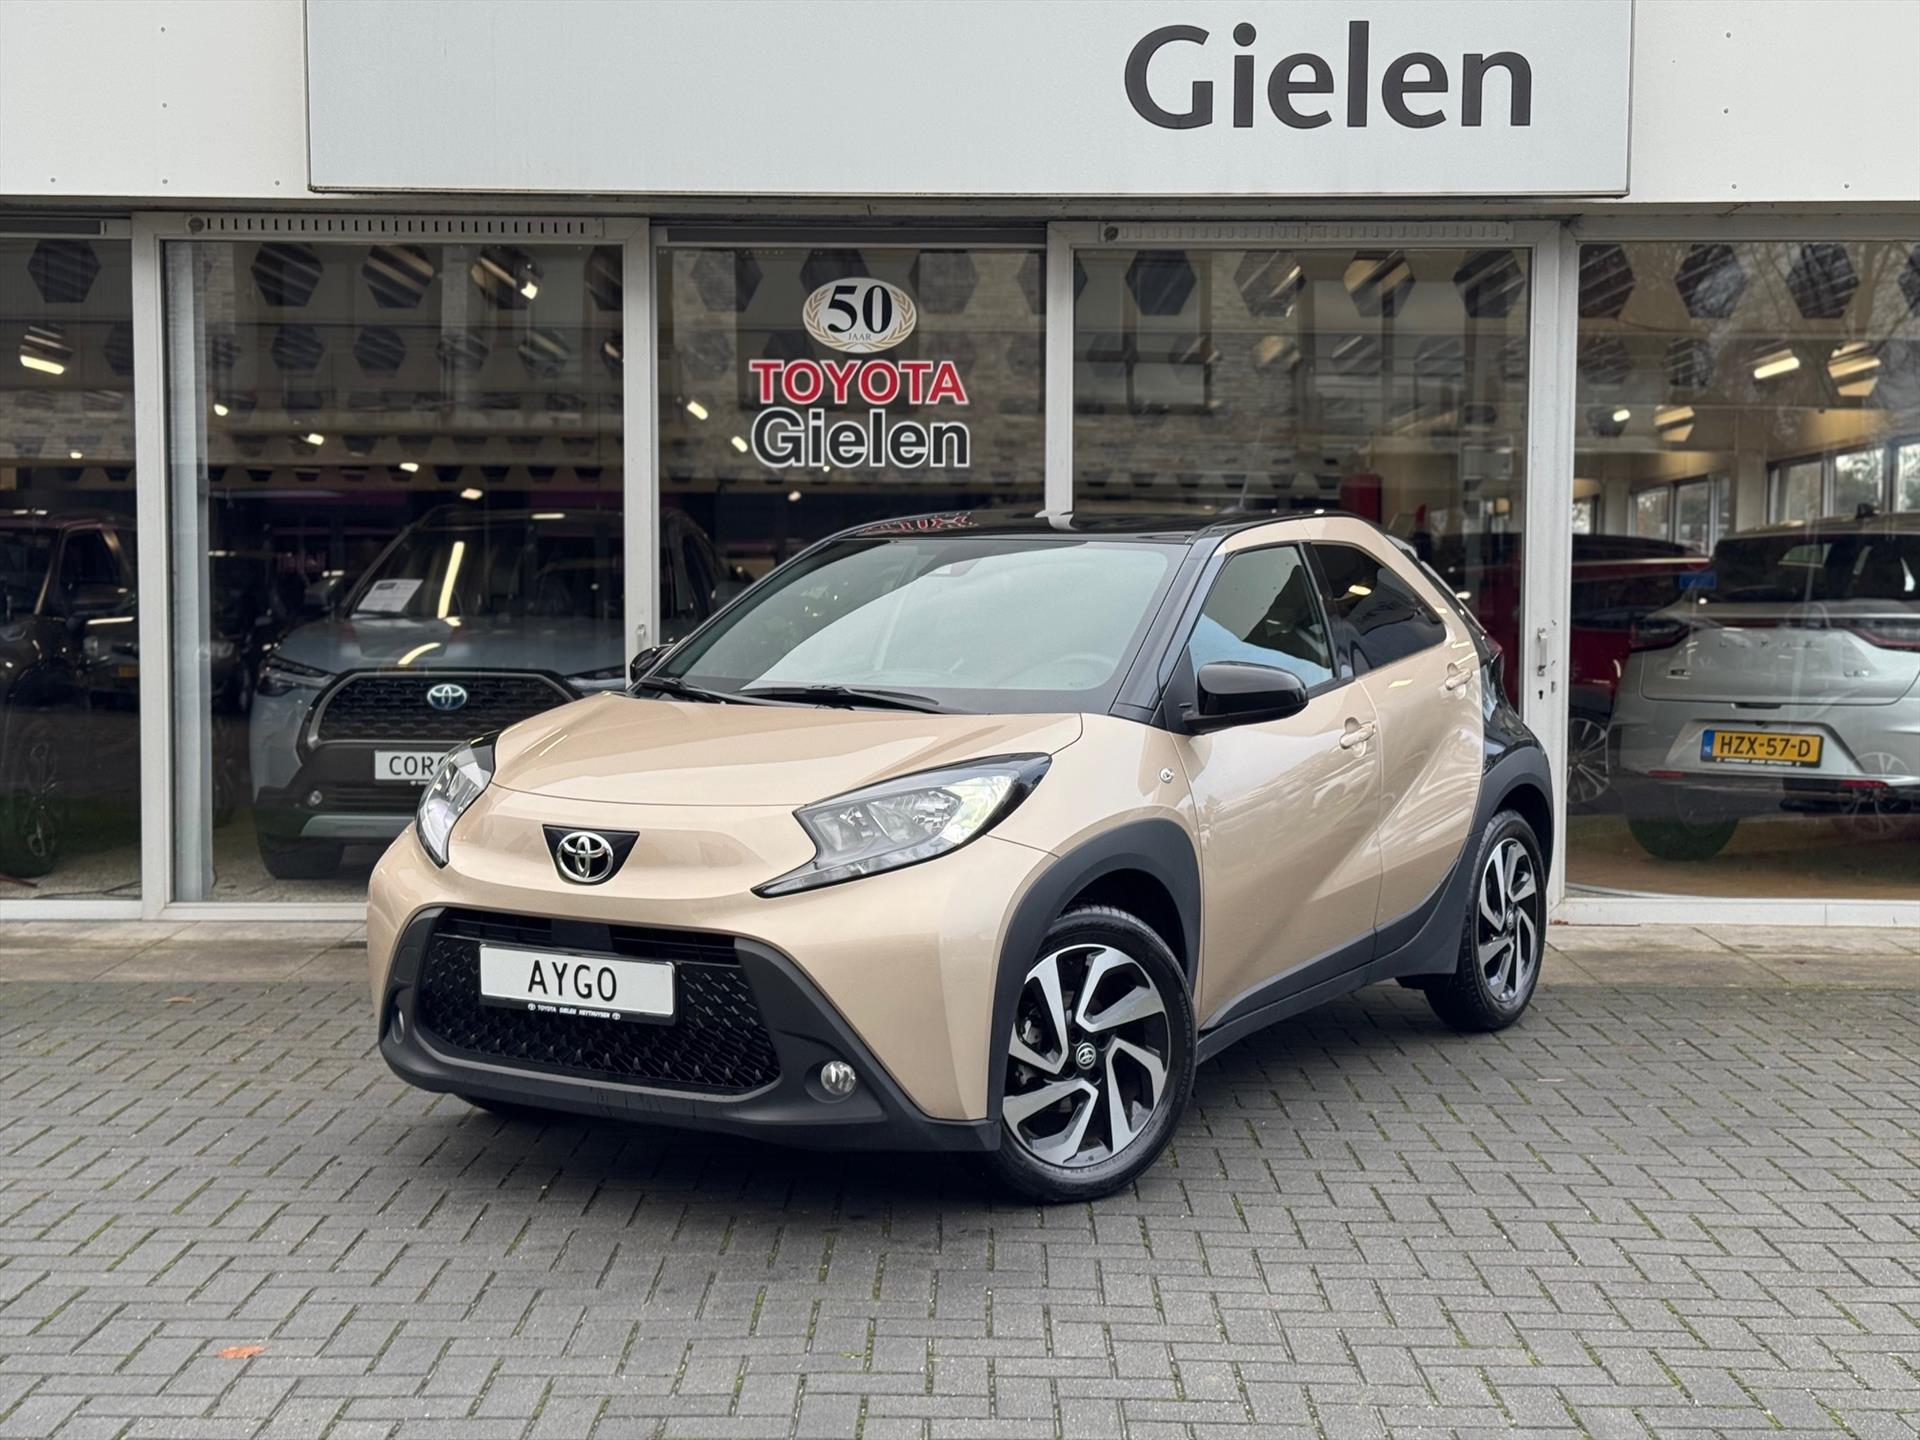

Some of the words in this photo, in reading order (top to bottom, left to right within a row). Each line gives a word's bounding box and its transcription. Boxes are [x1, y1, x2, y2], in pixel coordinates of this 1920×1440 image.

[1124, 20, 1532, 130] Gielen
[827, 285, 893, 334] 50
[848, 333, 872, 342] JAAR
[749, 359, 969, 405] TOYOTA
[751, 407, 970, 468] Gielen
[1719, 735, 1811, 757] HZX-57-D
[527, 959, 617, 1002] AYGO
